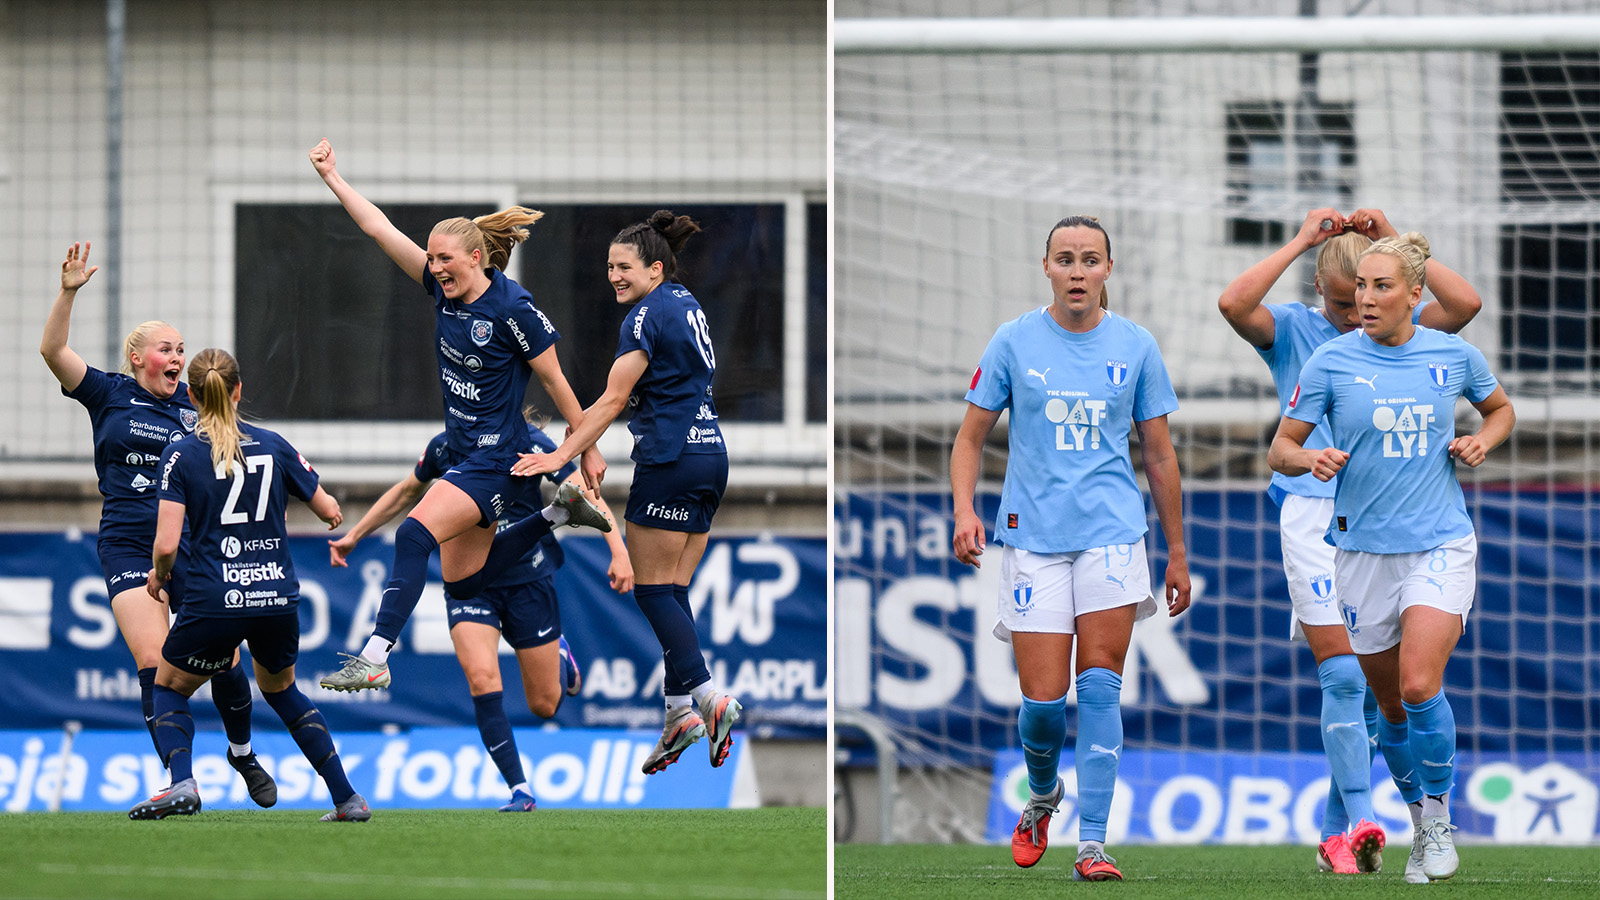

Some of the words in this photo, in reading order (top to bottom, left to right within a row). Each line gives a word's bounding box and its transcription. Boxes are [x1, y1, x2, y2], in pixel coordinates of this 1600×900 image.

[527, 301, 556, 335] stad
[633, 306, 648, 340] stadium
[506, 317, 531, 353] stadium
[686, 308, 716, 369] 19
[129, 419, 169, 434] Sparbanken
[1056, 424, 1100, 451] LY!
[1383, 431, 1428, 458] LY!
[161, 451, 181, 491] stadium
[215, 454, 274, 525] 27
[646, 503, 689, 521] friskis
[244, 538, 281, 552] KFAST
[1104, 545, 1133, 569] 19
[222, 561, 286, 586] logistik
[1429, 548, 1447, 573] 8
[245, 590, 278, 599] Eskilstuna
[246, 599, 267, 608] Energi
[187, 656, 231, 670] friskis
[582, 657, 638, 699] AB
[642, 651, 827, 702] LARPL
